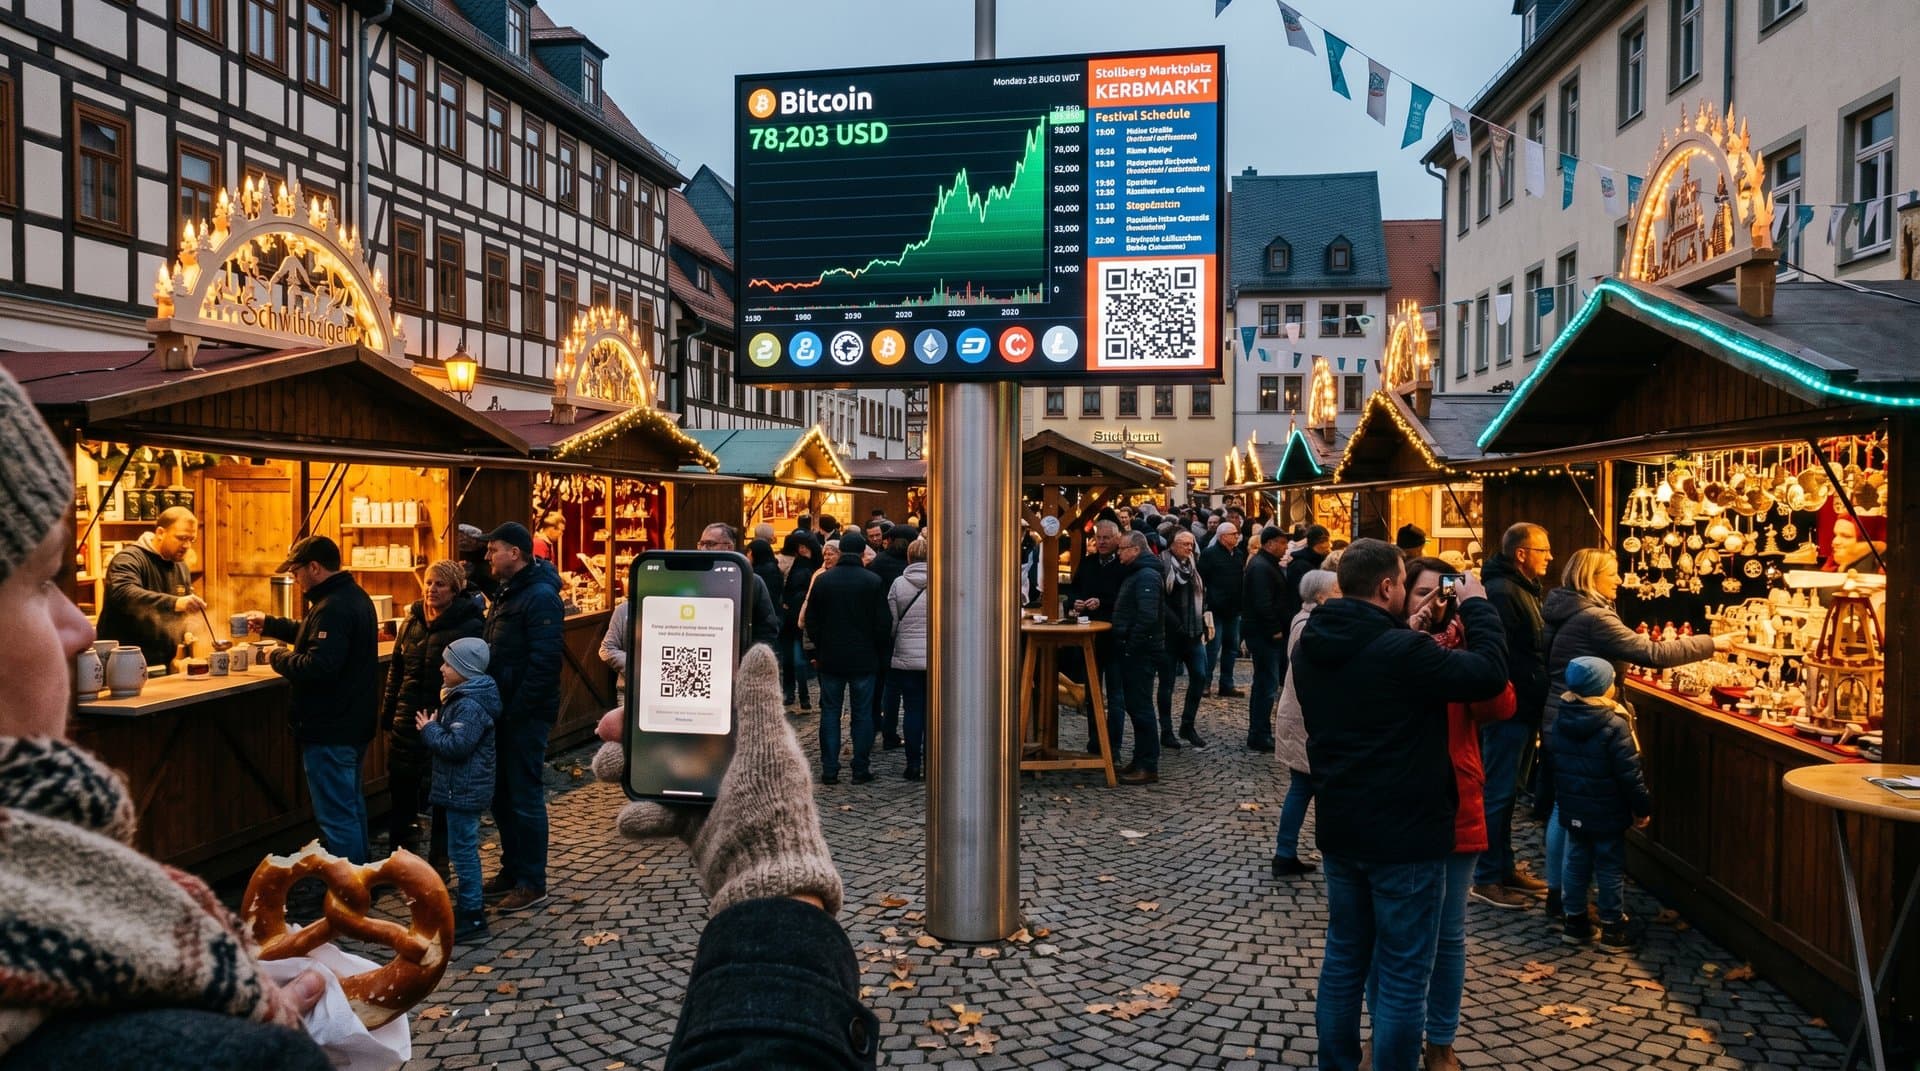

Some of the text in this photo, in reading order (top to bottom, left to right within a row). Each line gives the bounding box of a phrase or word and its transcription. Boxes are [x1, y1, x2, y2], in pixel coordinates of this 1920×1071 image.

[1096, 63, 1212, 78] Stollberg Marktplatz
[1095, 78, 1212, 100] KERBMARKT
[780, 85, 873, 115] Bitcoin
[1095, 110, 1138, 123] Festival
[1140, 108, 1191, 121] Schedule
[749, 121, 888, 153] 78,203 USD
[1054, 165, 1080, 173] 52,000
[1054, 185, 1080, 194] 50,000
[1054, 204, 1080, 214] 40,000
[1054, 224, 1080, 234] 33,000
[1054, 245, 1080, 254] 22,000
[1054, 265, 1080, 274] 11,000
[1053, 285, 1061, 294] 0
[895, 311, 913, 319] 2020
[947, 309, 966, 317] 2020
[1001, 308, 1020, 316] 2020
